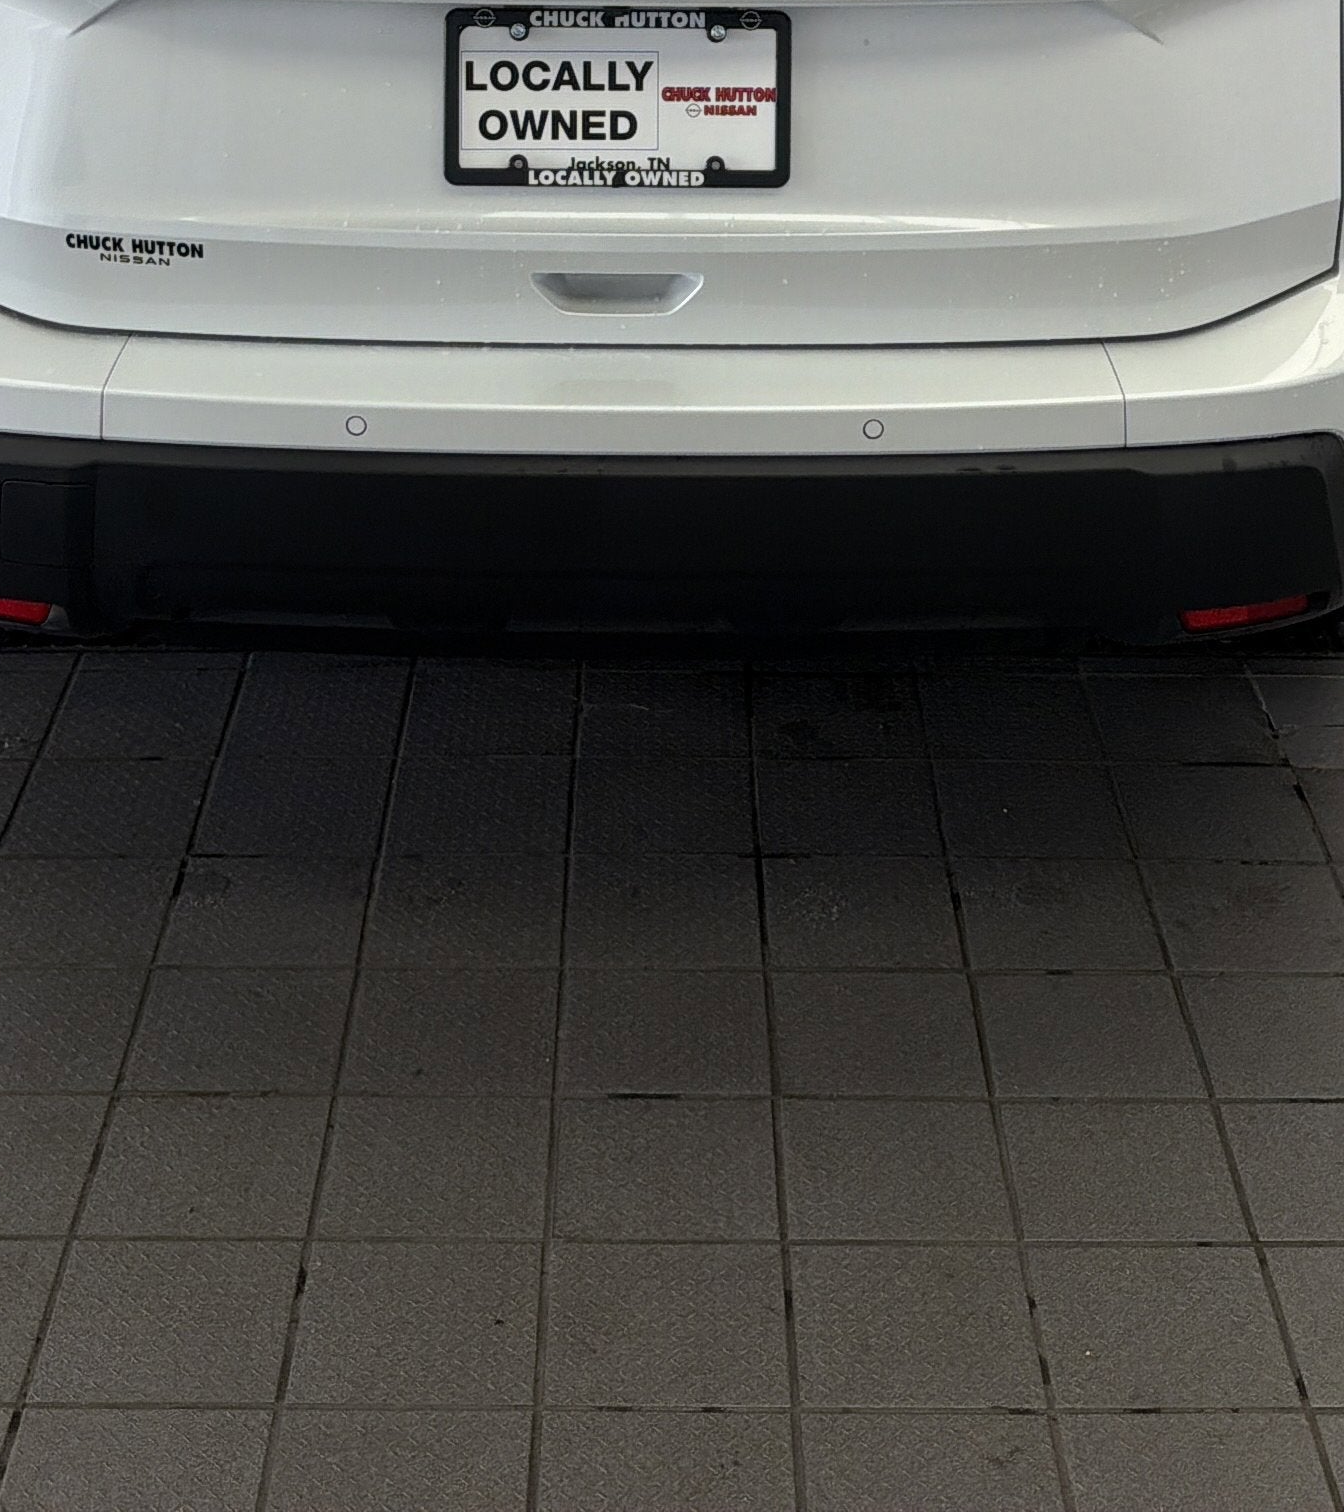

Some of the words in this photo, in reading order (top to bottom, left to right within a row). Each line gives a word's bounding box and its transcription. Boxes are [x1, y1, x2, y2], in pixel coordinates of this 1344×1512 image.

[529, 10, 606, 27] CHUCK
[614, 11, 706, 28] HUTTON
[465, 60, 654, 91] LOCALLY
[661, 86, 711, 102] CHUCK
[715, 87, 777, 102] HUTTON
[703, 105, 758, 116] NISSAN
[478, 109, 638, 141] OWNED
[647, 157, 671, 171] TN
[528, 170, 617, 186] LOCALLY
[624, 171, 705, 186] OWNED
[65, 232, 125, 252] CHUCK
[131, 238, 204, 258] HUTTON
[99, 252, 171, 266] NISSAN
